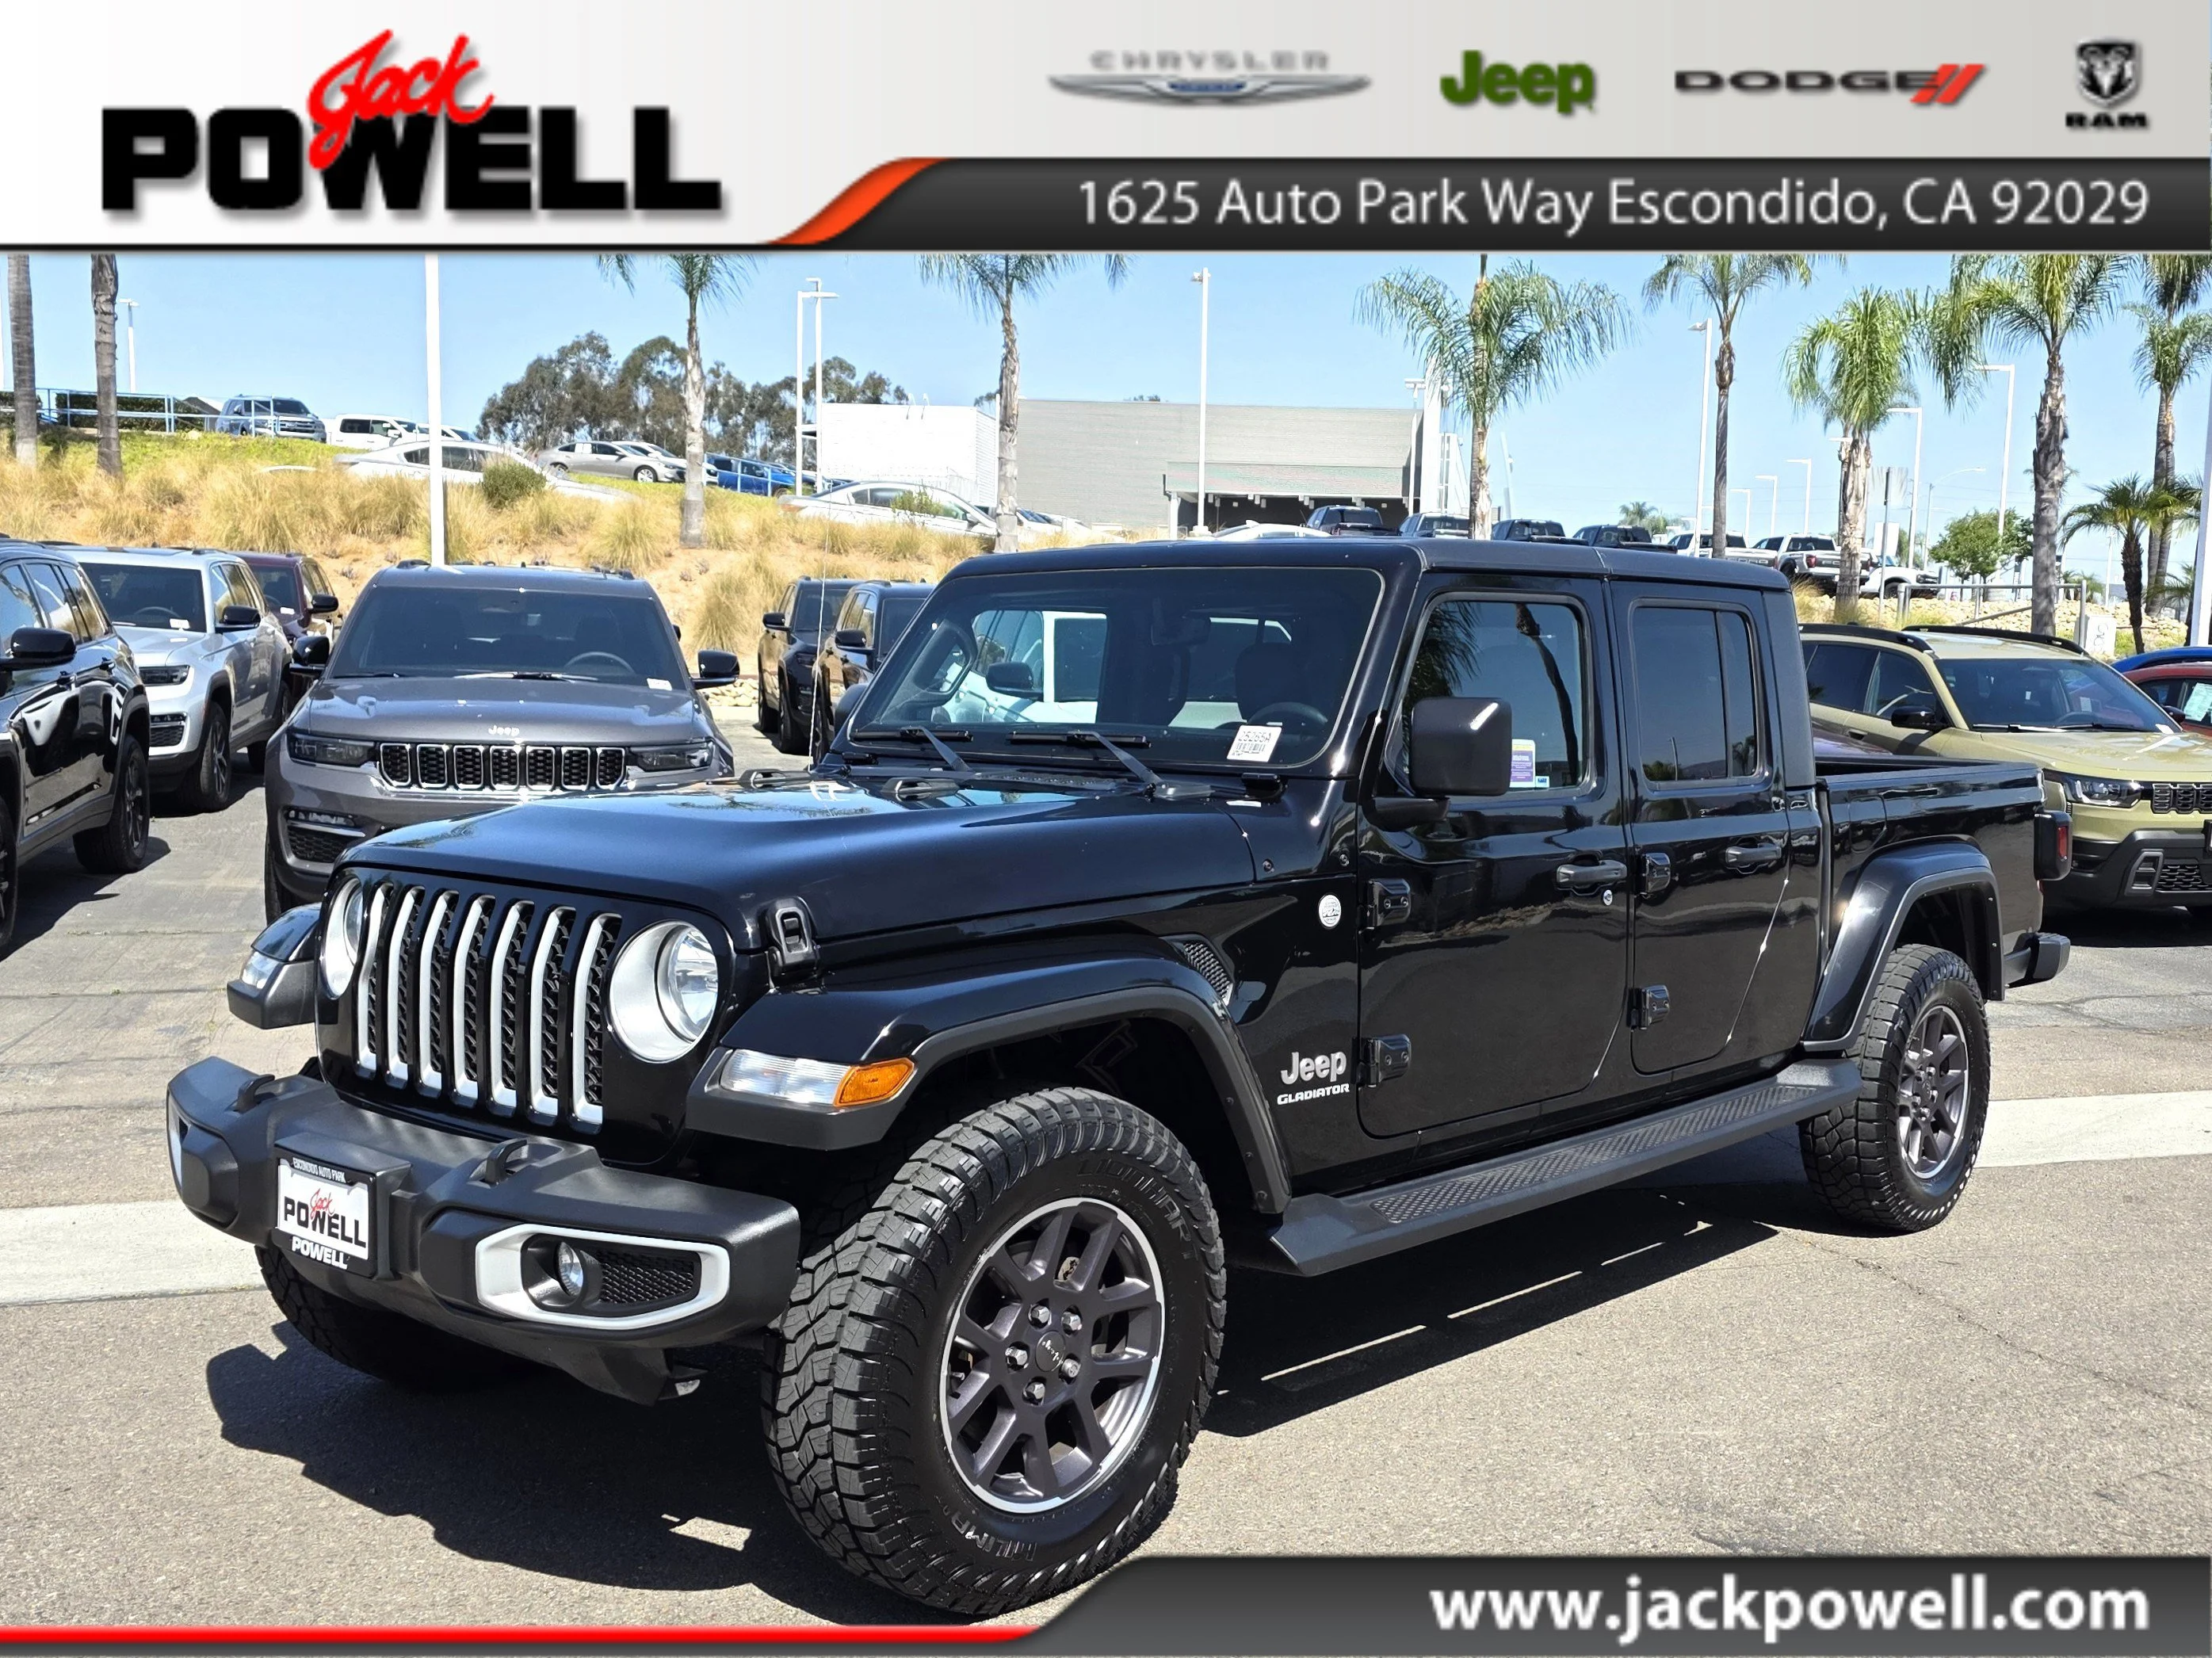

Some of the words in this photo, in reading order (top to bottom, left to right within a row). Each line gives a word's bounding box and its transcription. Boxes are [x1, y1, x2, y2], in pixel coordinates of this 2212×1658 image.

[488, 724, 520, 737] Jeep
[1280, 1051, 1347, 1085] Jeep
[1277, 1083, 1351, 1106] GLADIATOR
[319, 1166, 331, 1179] AUTO
[331, 1169, 346, 1183] PARK
[310, 1188, 335, 1221] Jack
[284, 1196, 366, 1248] POWELL
[291, 1236, 348, 1270] POWELL
